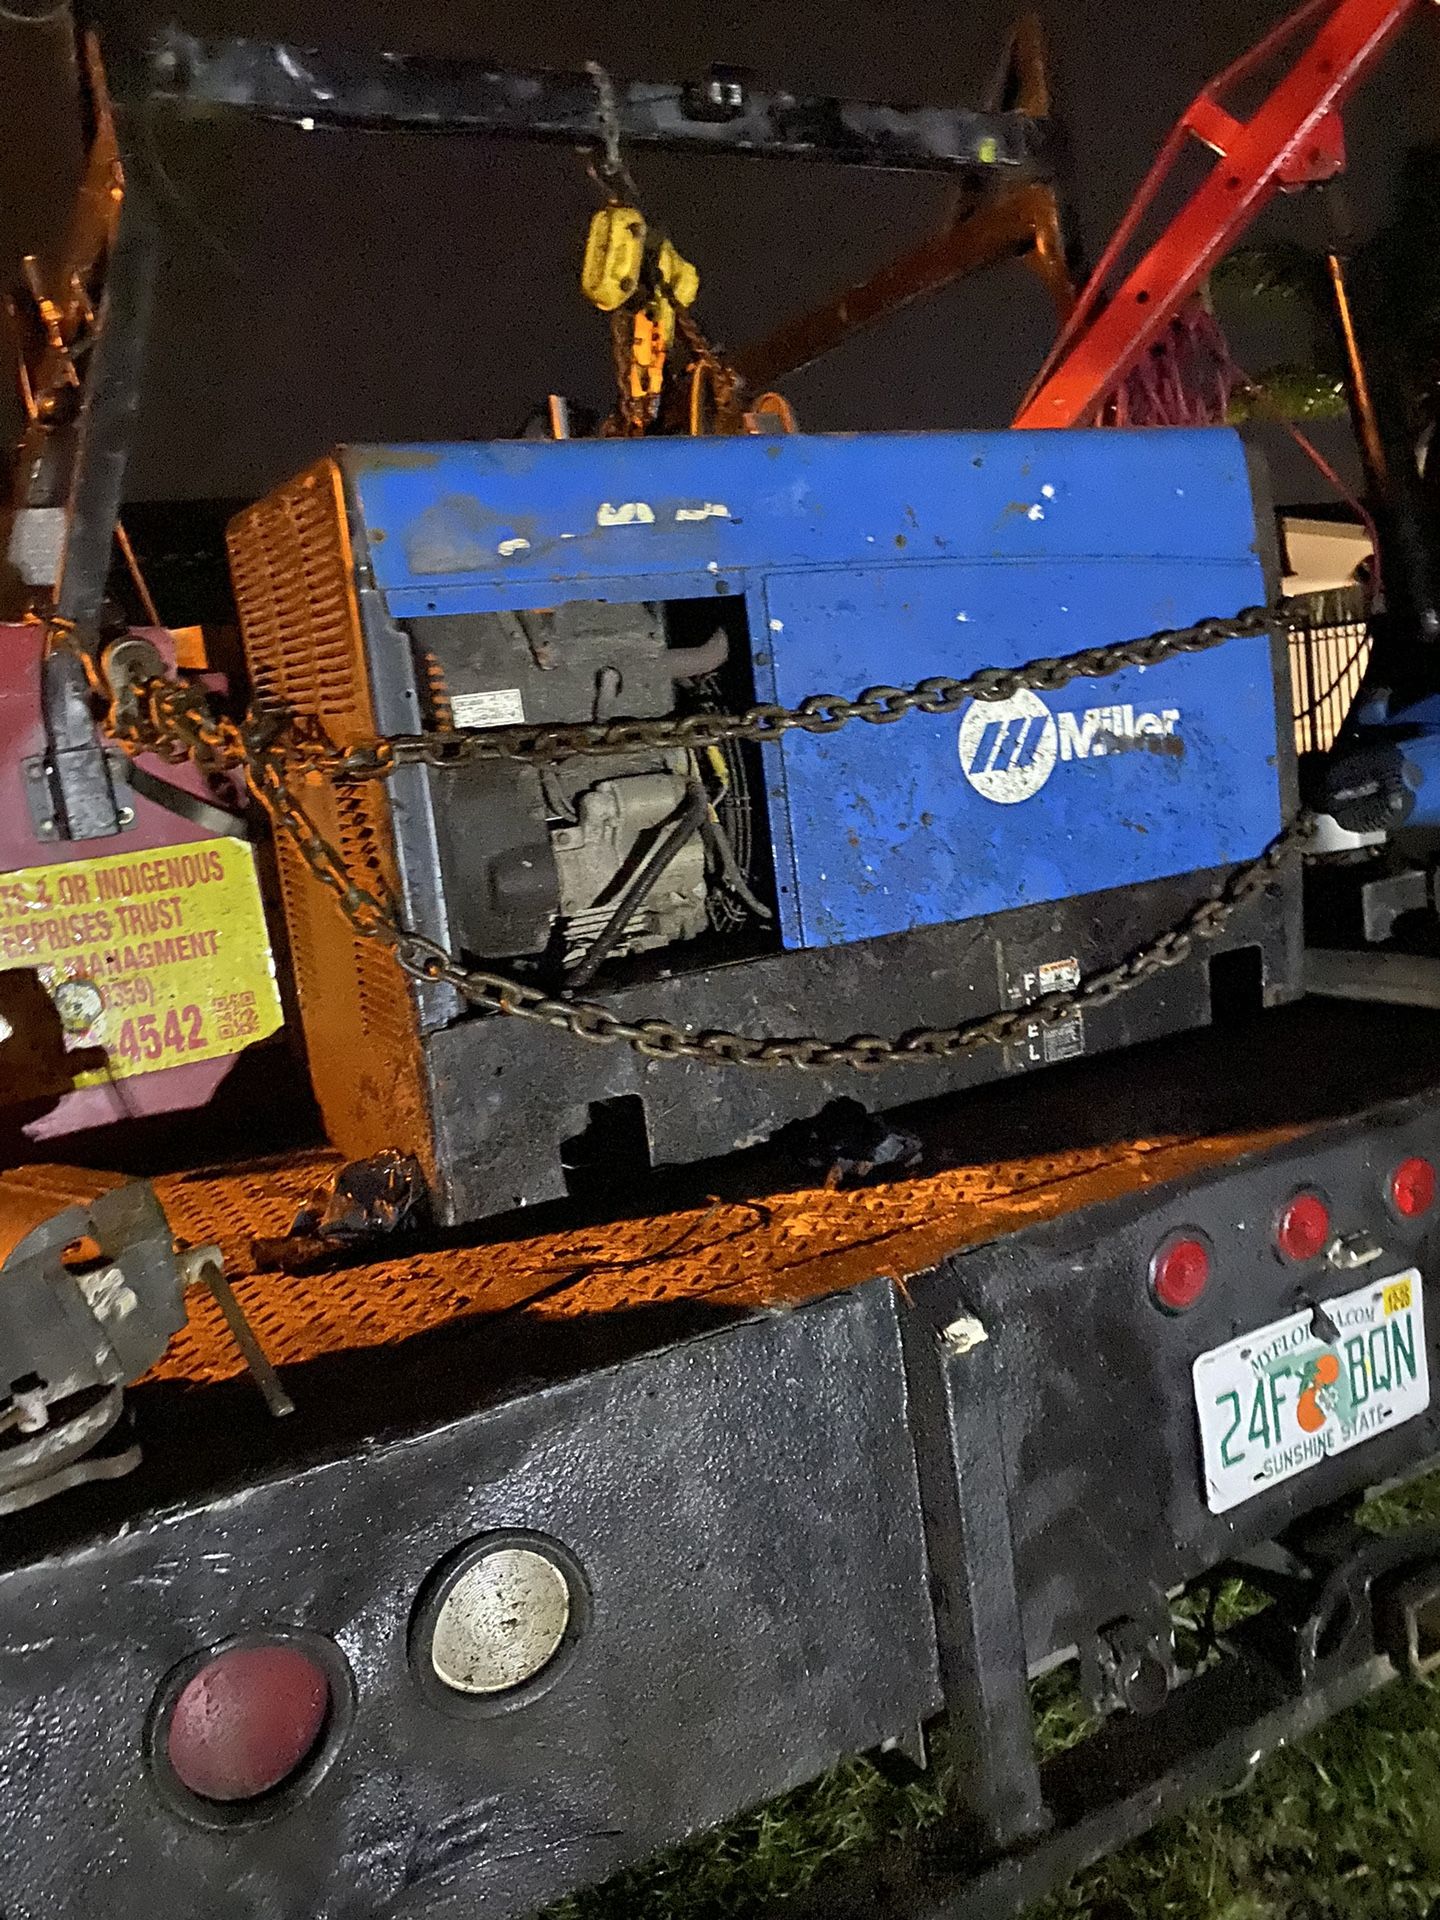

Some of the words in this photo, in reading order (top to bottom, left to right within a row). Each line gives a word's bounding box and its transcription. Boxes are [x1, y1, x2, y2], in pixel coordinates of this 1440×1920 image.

[1057, 704, 1180, 760] Miller
[58, 874, 89, 905] OR
[95, 851, 225, 902] INDIGENOUS
[115, 896, 183, 938] TRUST
[1215, 1366, 1292, 1469] 24F
[1343, 1312, 1417, 1408] BQN
[1262, 1431, 1334, 1479] SUNSHINE
[1341, 1402, 1386, 1444] STATE
